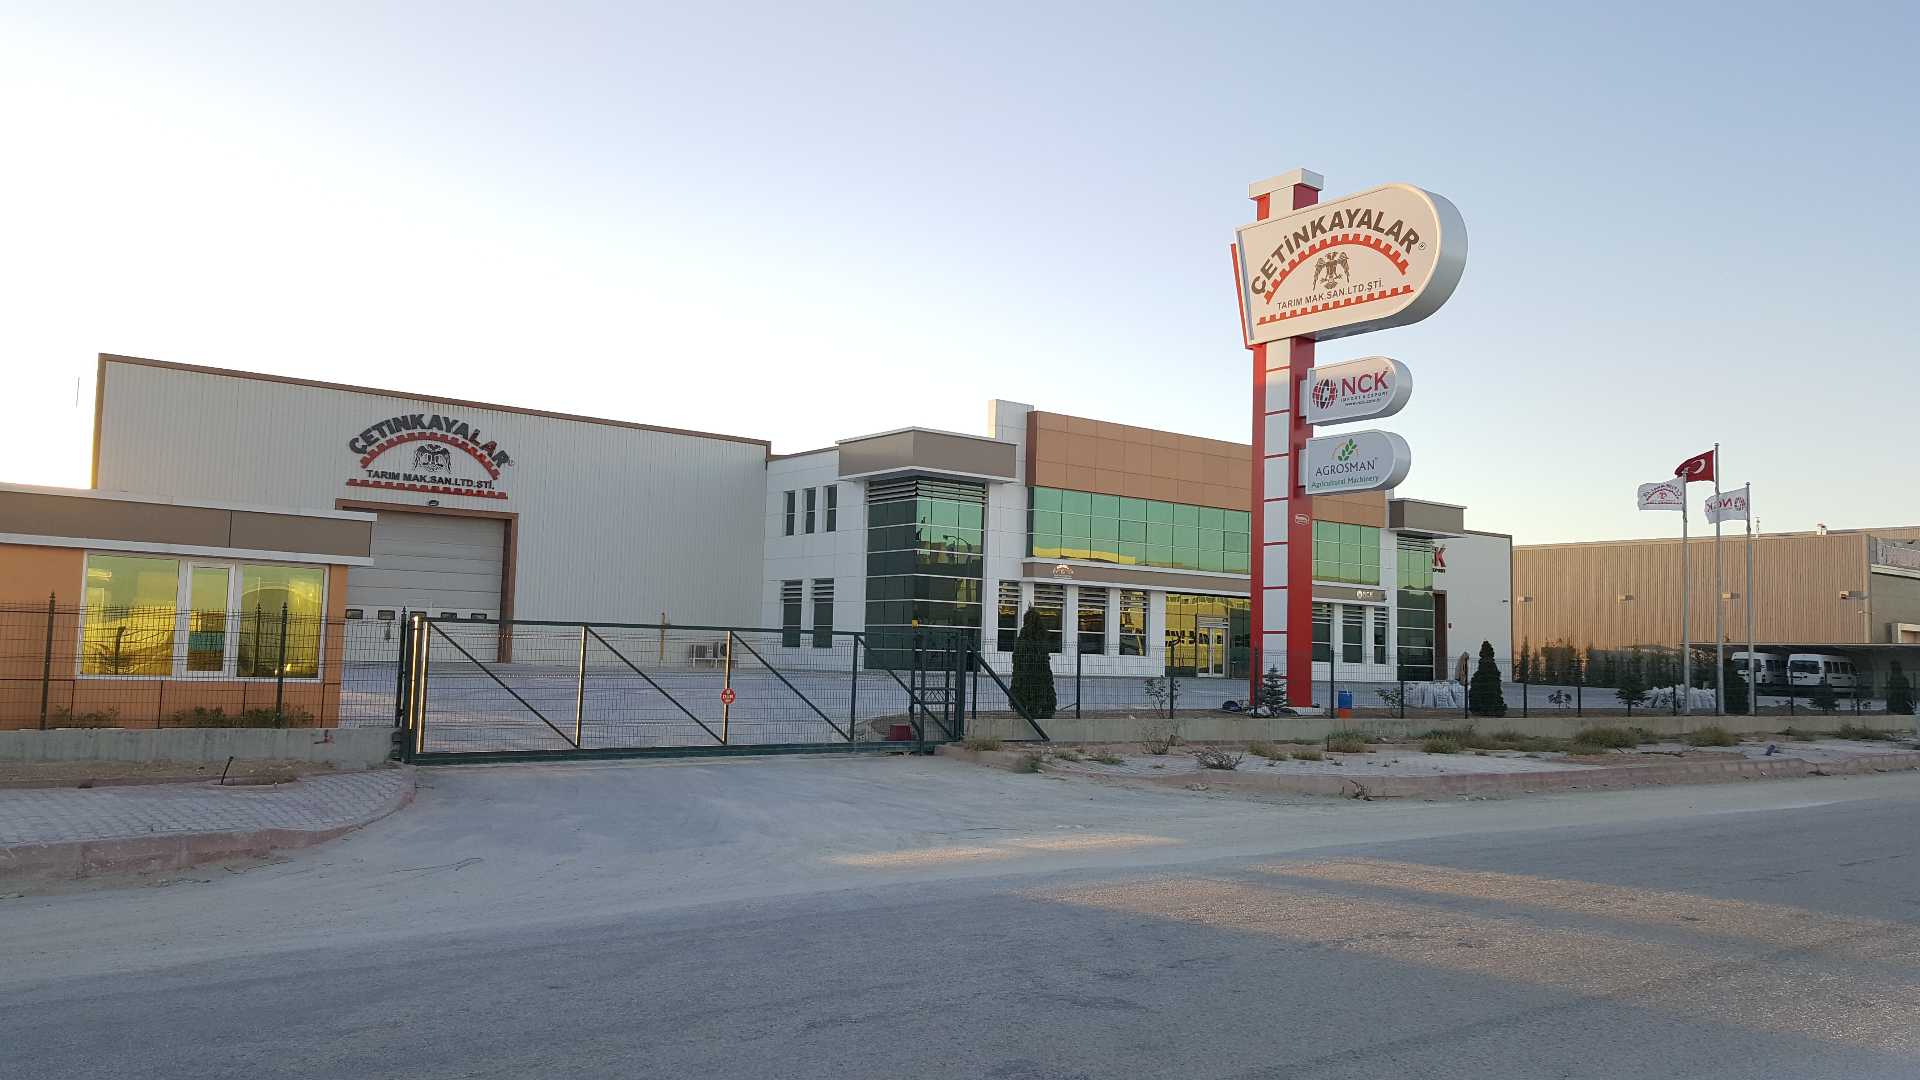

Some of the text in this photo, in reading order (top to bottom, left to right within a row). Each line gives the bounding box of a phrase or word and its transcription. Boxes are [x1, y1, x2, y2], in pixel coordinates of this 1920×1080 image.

[1251, 208, 1420, 295] ÇETİNKAYALAR
[1277, 298, 1303, 310] TARIM
[1341, 370, 1389, 397] NCK
[366, 469, 400, 481] TARIM
[1315, 459, 1375, 477] AGROSMAN
